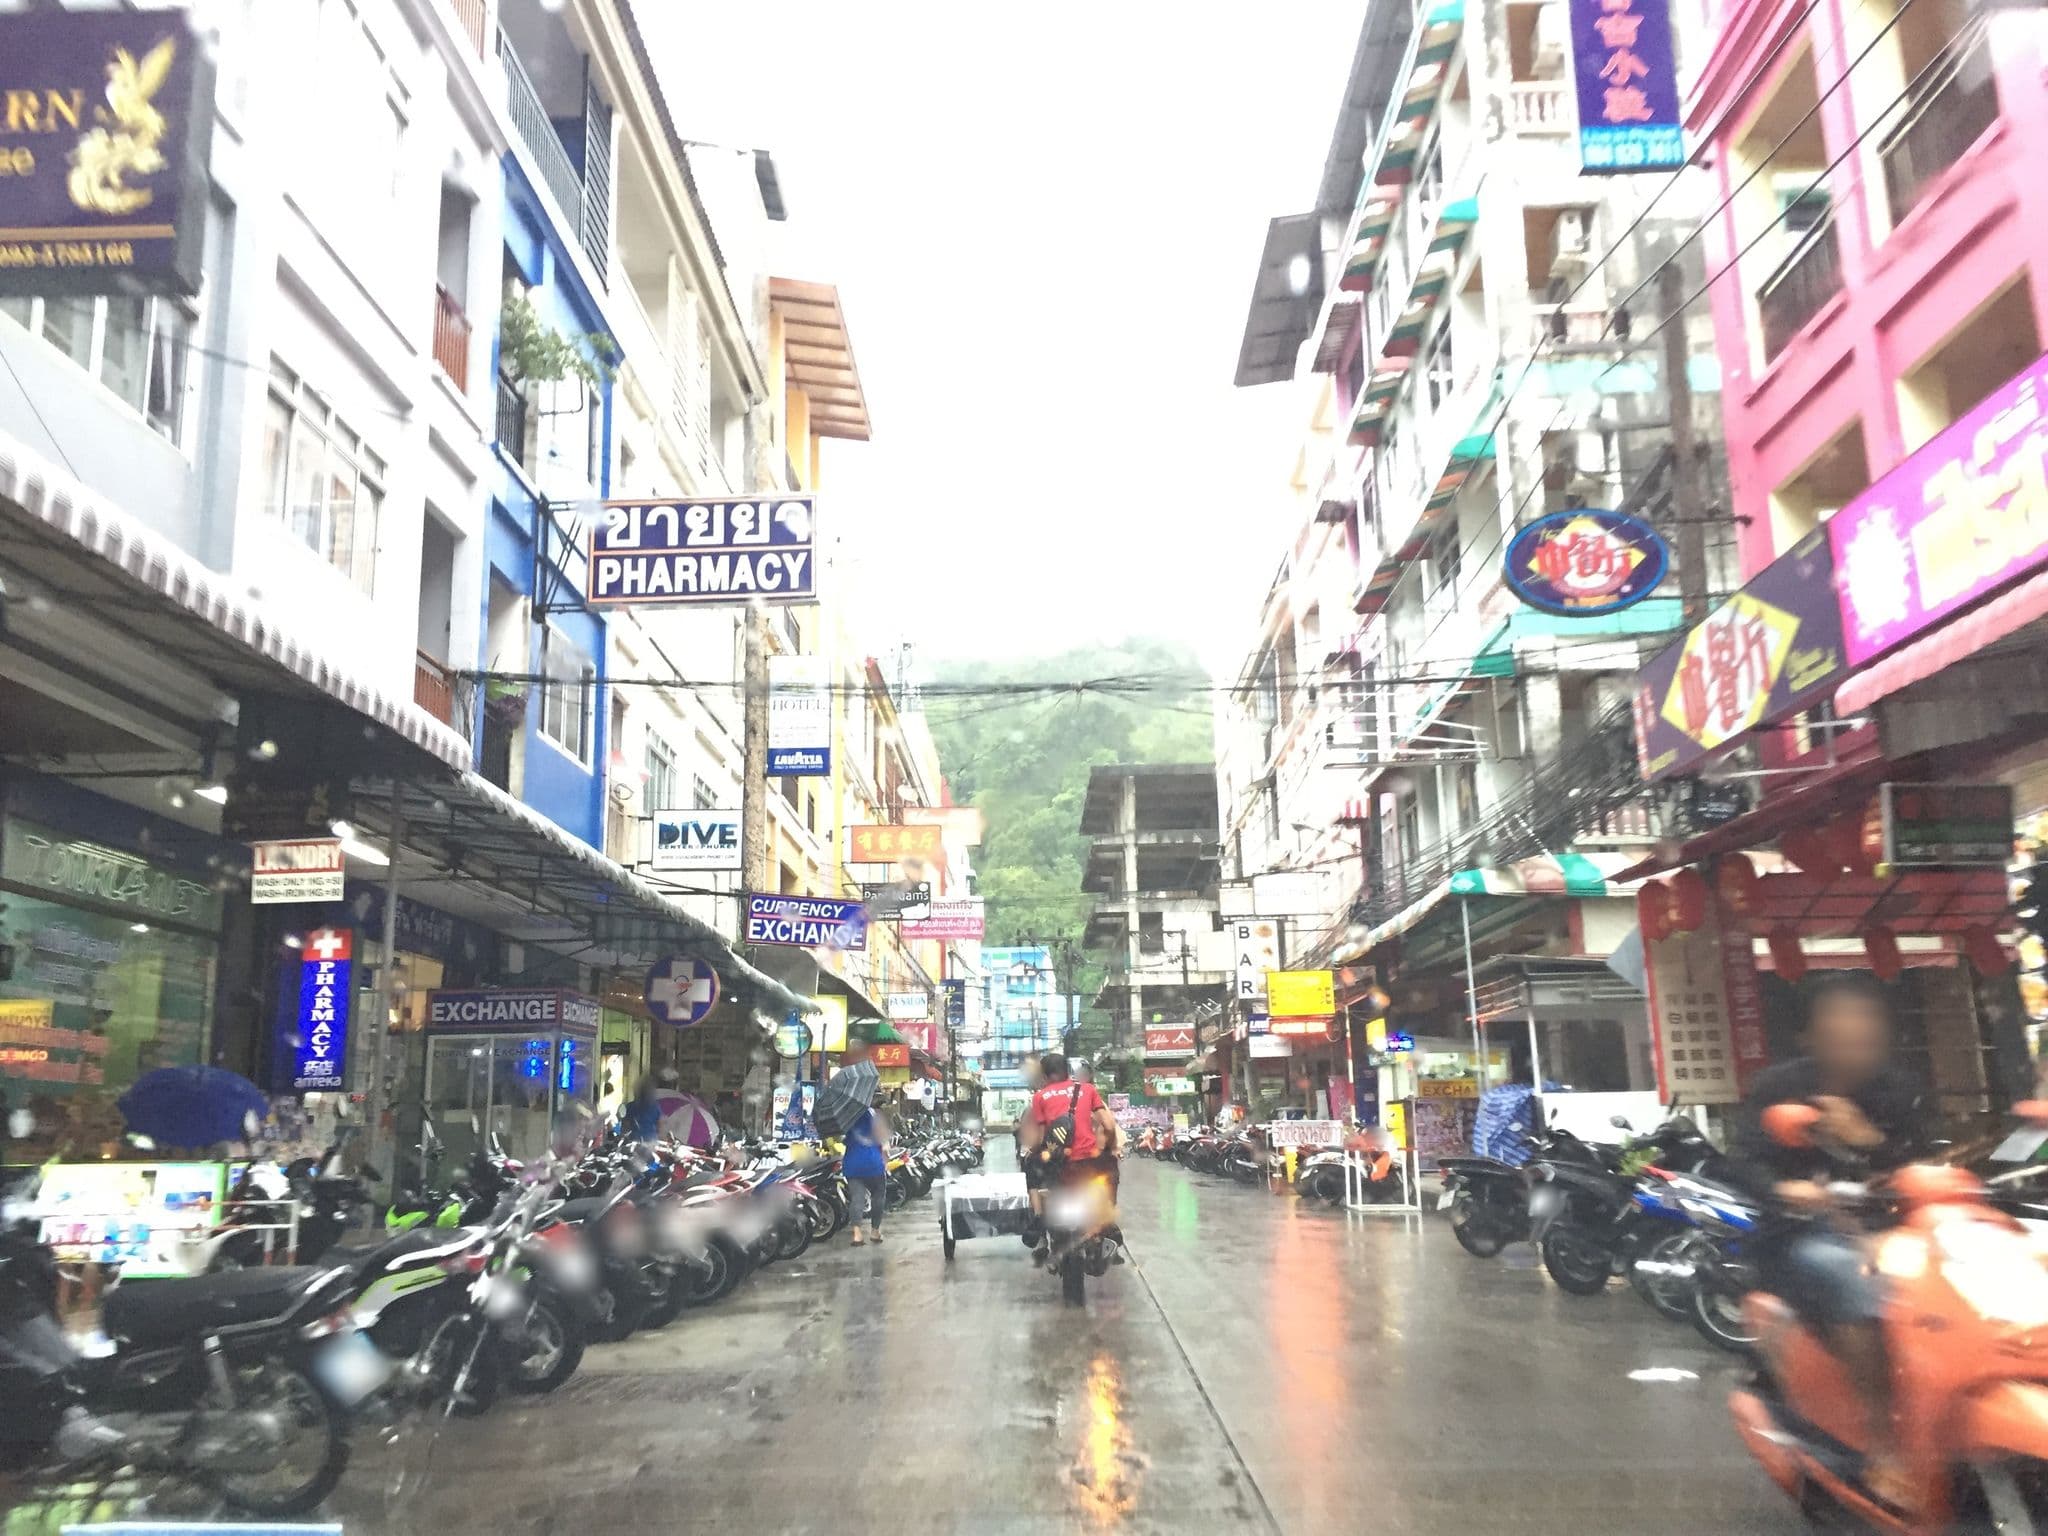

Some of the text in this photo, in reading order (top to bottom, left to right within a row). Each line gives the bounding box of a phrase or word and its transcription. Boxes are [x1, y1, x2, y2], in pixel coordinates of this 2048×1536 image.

[0, 88, 83, 132] RN
[602, 501, 809, 548] ขายยา
[598, 552, 808, 595] PHARMACY
[772, 699, 826, 711] HOTEL
[774, 751, 824, 765] LAVAZZA
[658, 821, 738, 845] DIVE
[1238, 926, 1254, 993] BAR
[310, 961, 336, 1057] PHARMACY
[431, 1000, 556, 1022] EXCHANGE
[1423, 1083, 1474, 1097] EXCHA
